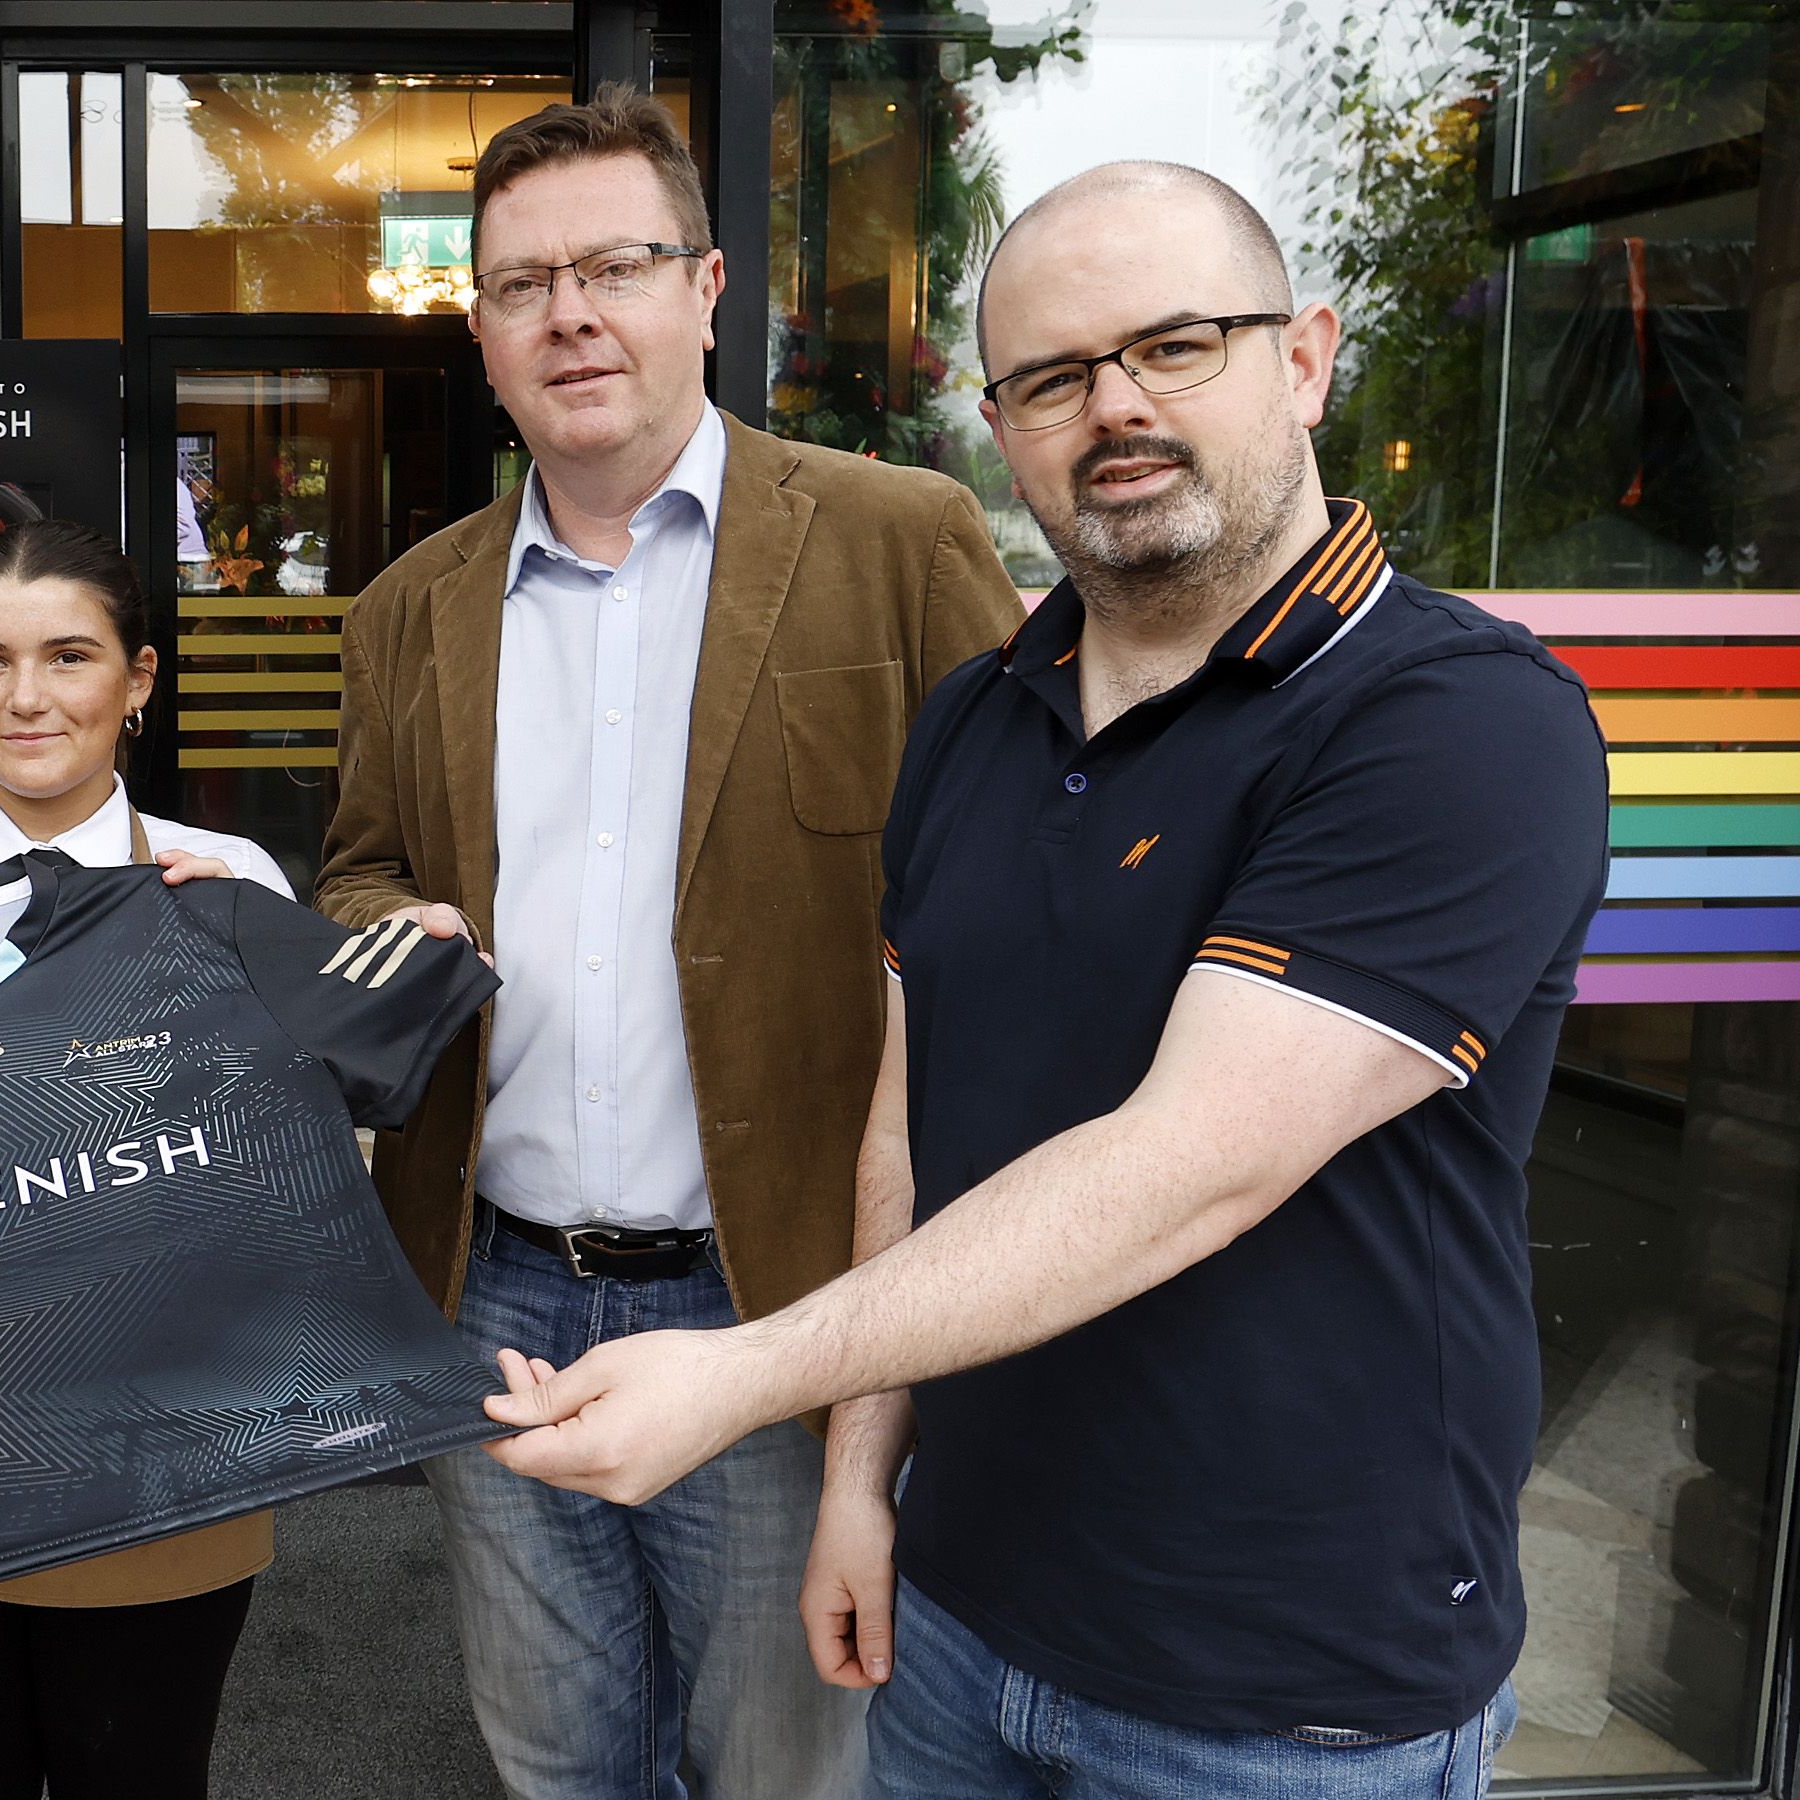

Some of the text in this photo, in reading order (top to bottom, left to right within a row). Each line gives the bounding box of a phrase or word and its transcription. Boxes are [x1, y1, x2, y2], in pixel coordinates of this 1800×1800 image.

[95, 1031, 172, 1052] ANTRIM 23
[95, 1047, 117, 1057] ALL
